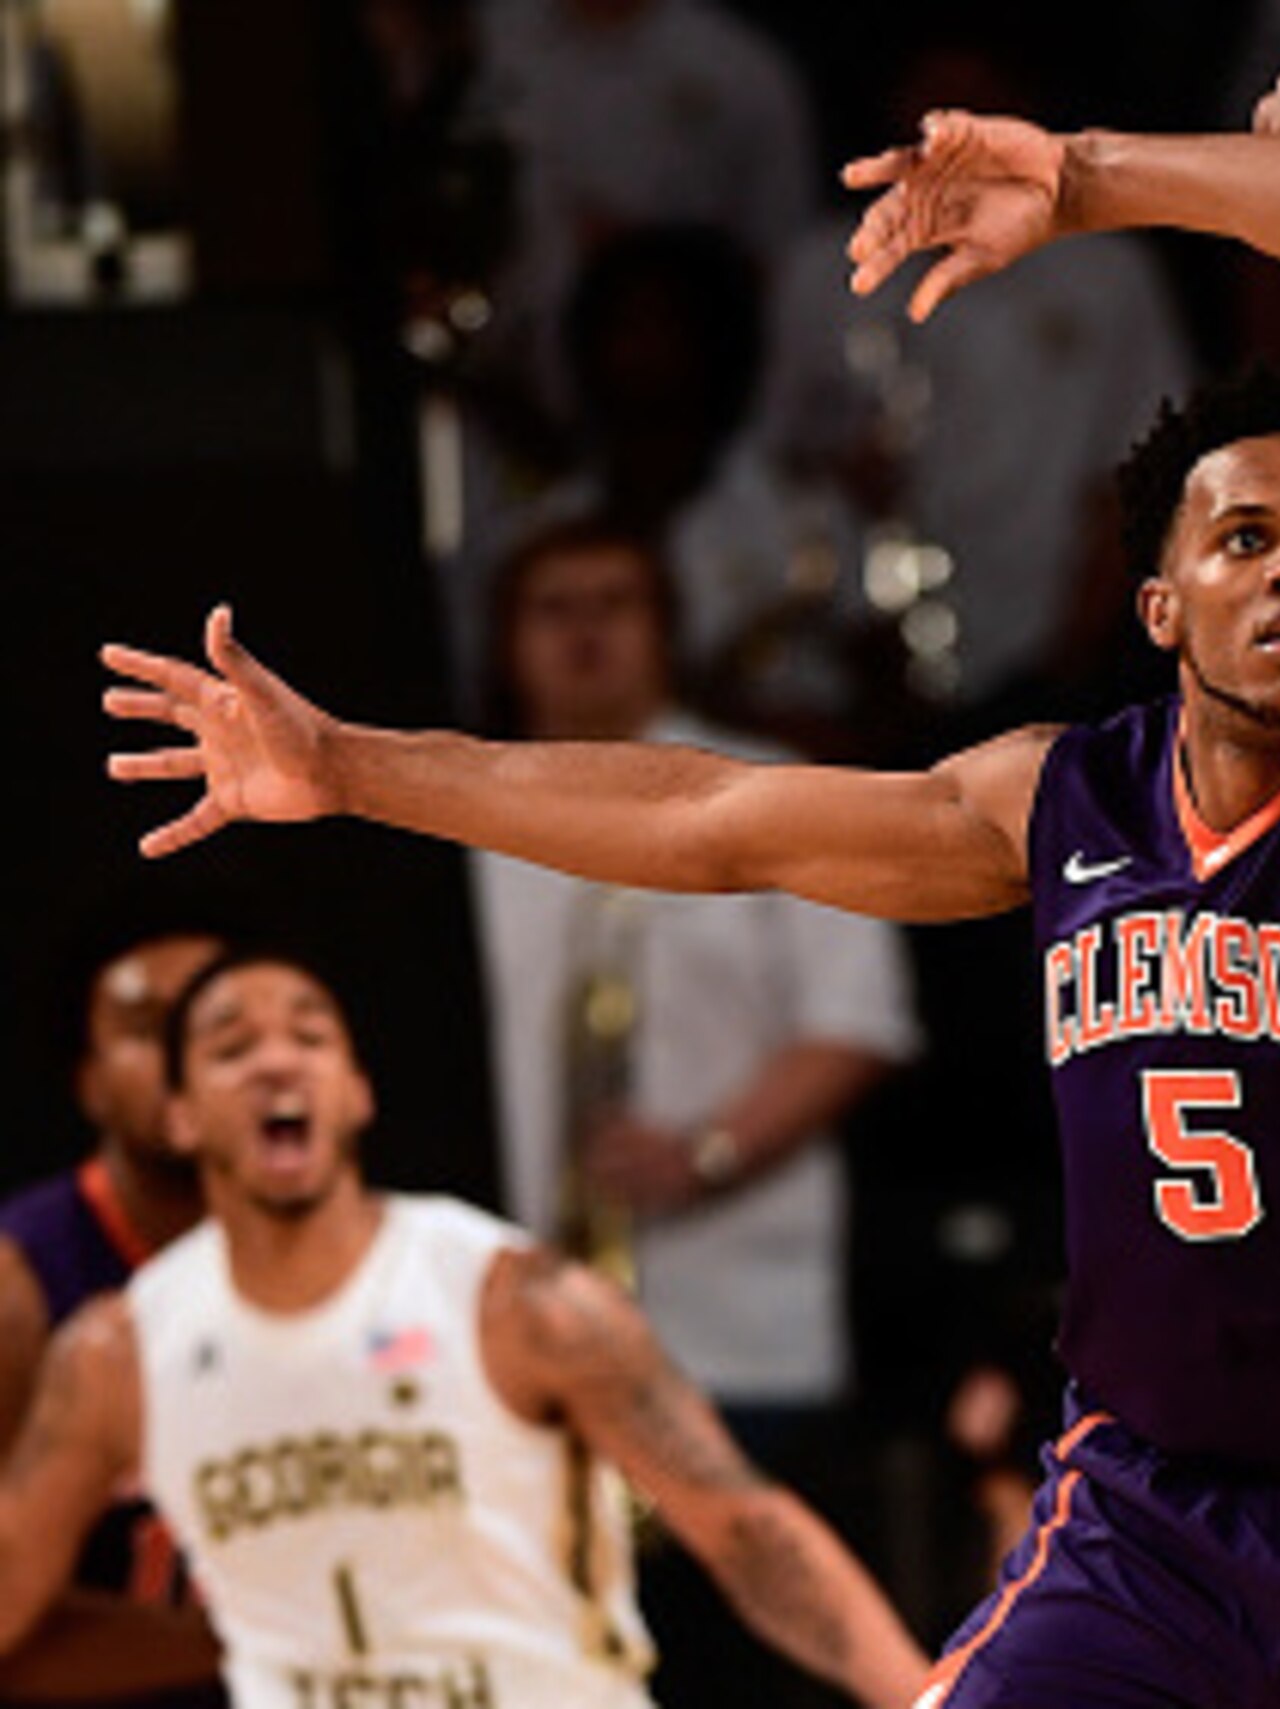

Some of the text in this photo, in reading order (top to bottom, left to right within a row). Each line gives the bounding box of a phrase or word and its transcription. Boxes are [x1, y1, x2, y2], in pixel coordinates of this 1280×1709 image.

[1140, 1068, 1263, 1241] 5
[193, 1427, 466, 1543] GEORGIA
[333, 1560, 369, 1656] 1
